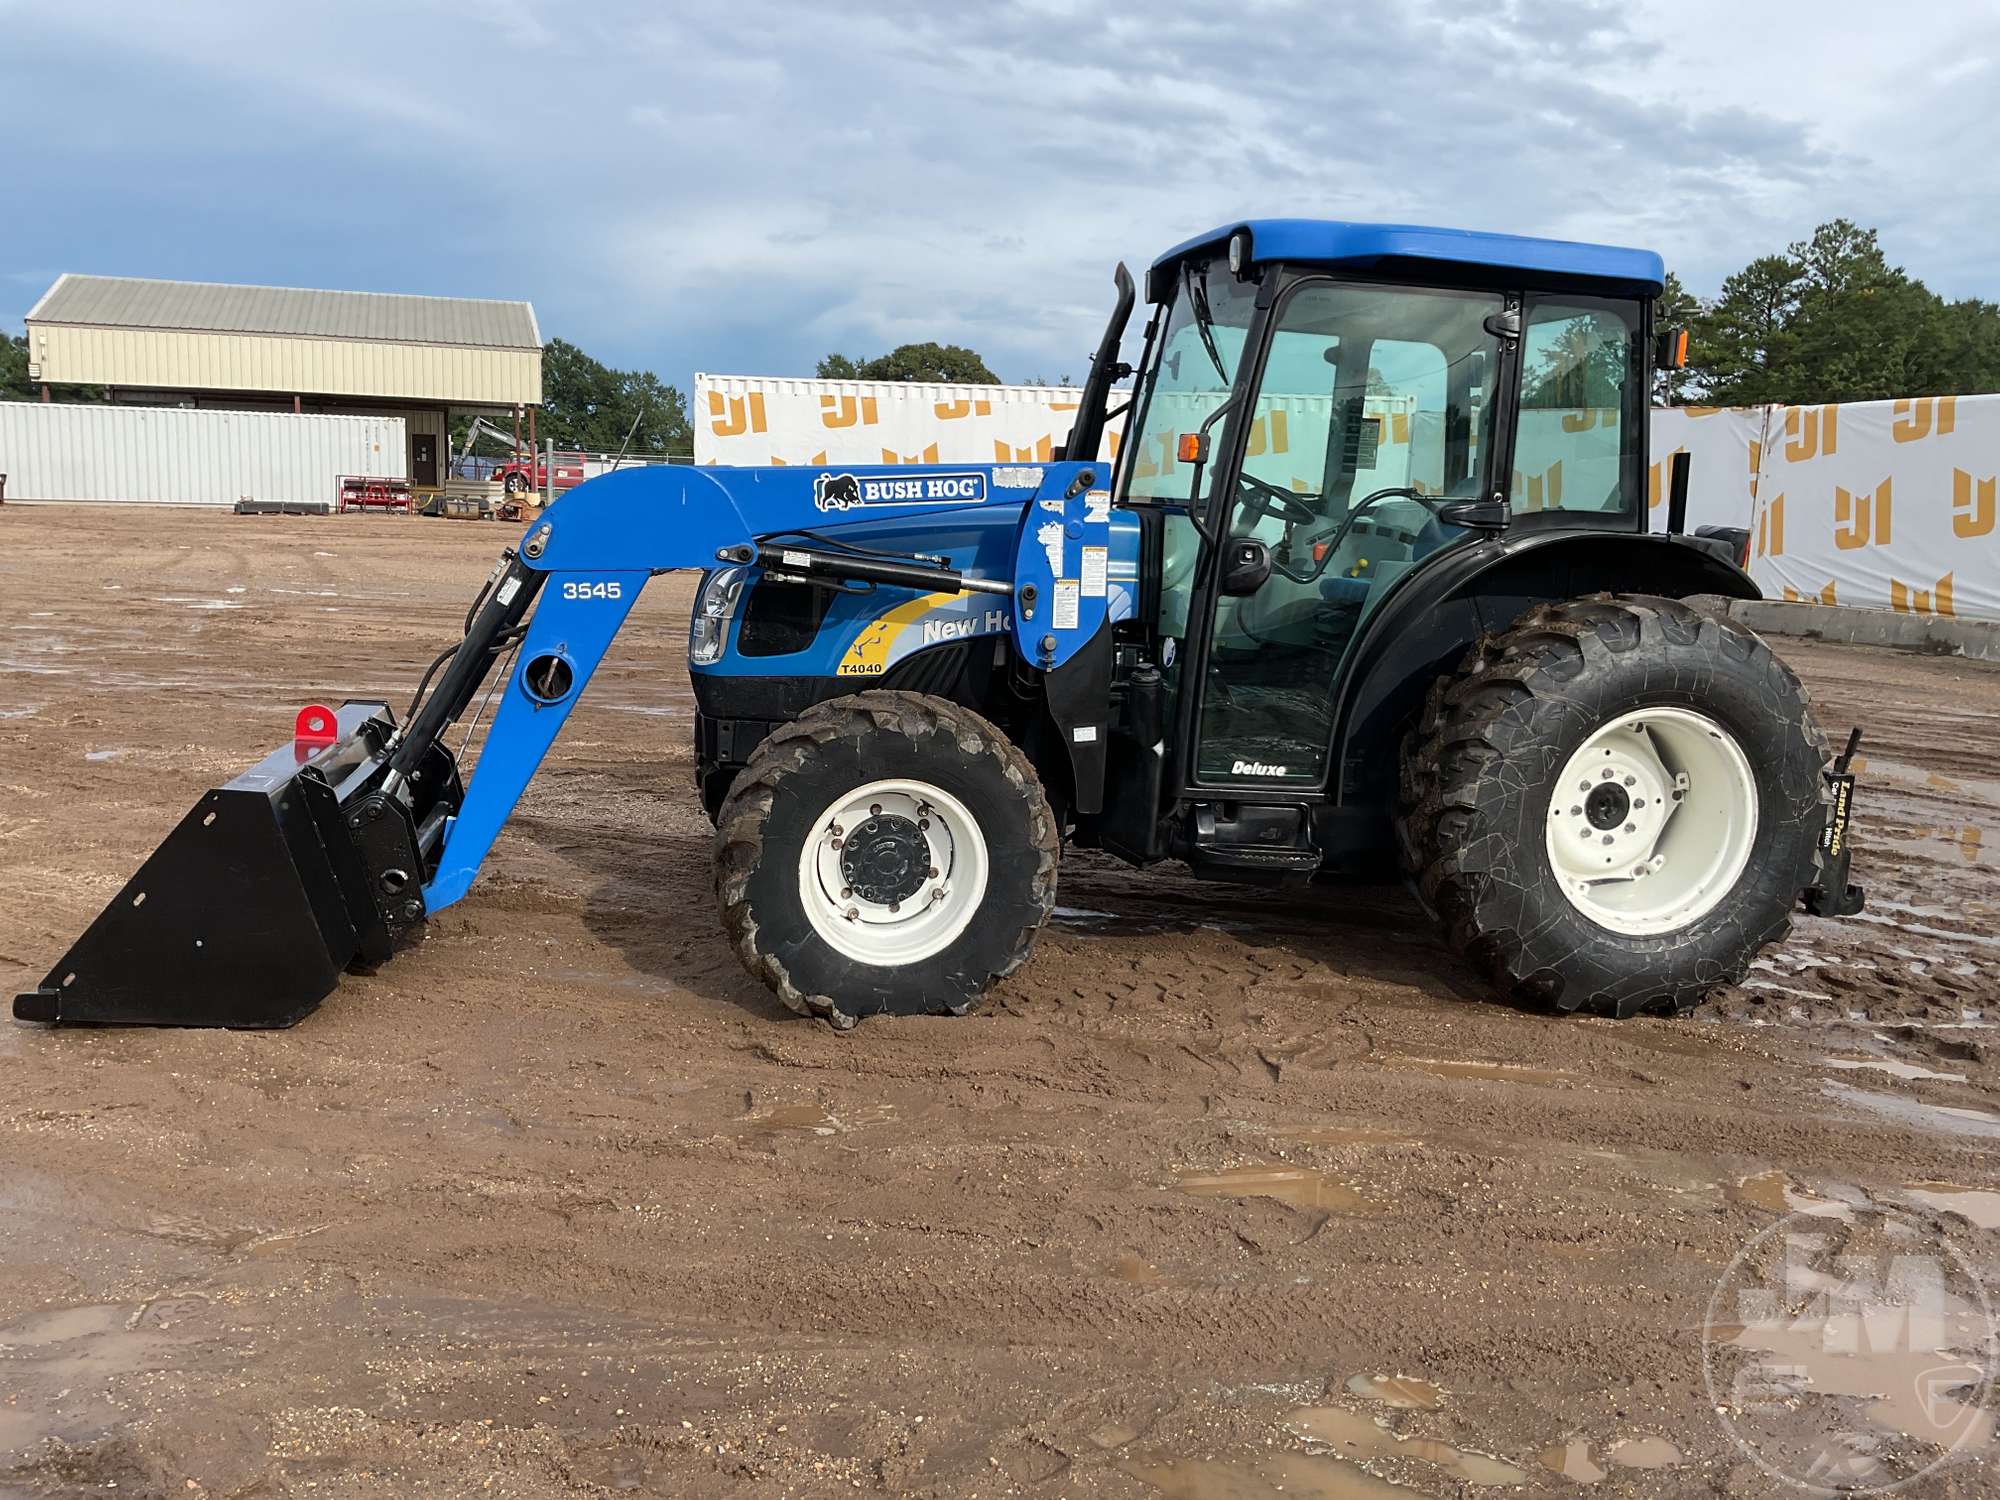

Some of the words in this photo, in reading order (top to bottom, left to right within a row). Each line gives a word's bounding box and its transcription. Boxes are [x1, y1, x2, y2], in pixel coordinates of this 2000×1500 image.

[865, 480, 922, 500] BUSH
[563, 582, 621, 599] 3545
[923, 617, 978, 644] New
[841, 664, 882, 674] T4040
[1231, 760, 1286, 776] Deluxe
[1837, 781, 1850, 816] Land
[1831, 818, 1844, 856] Pride
